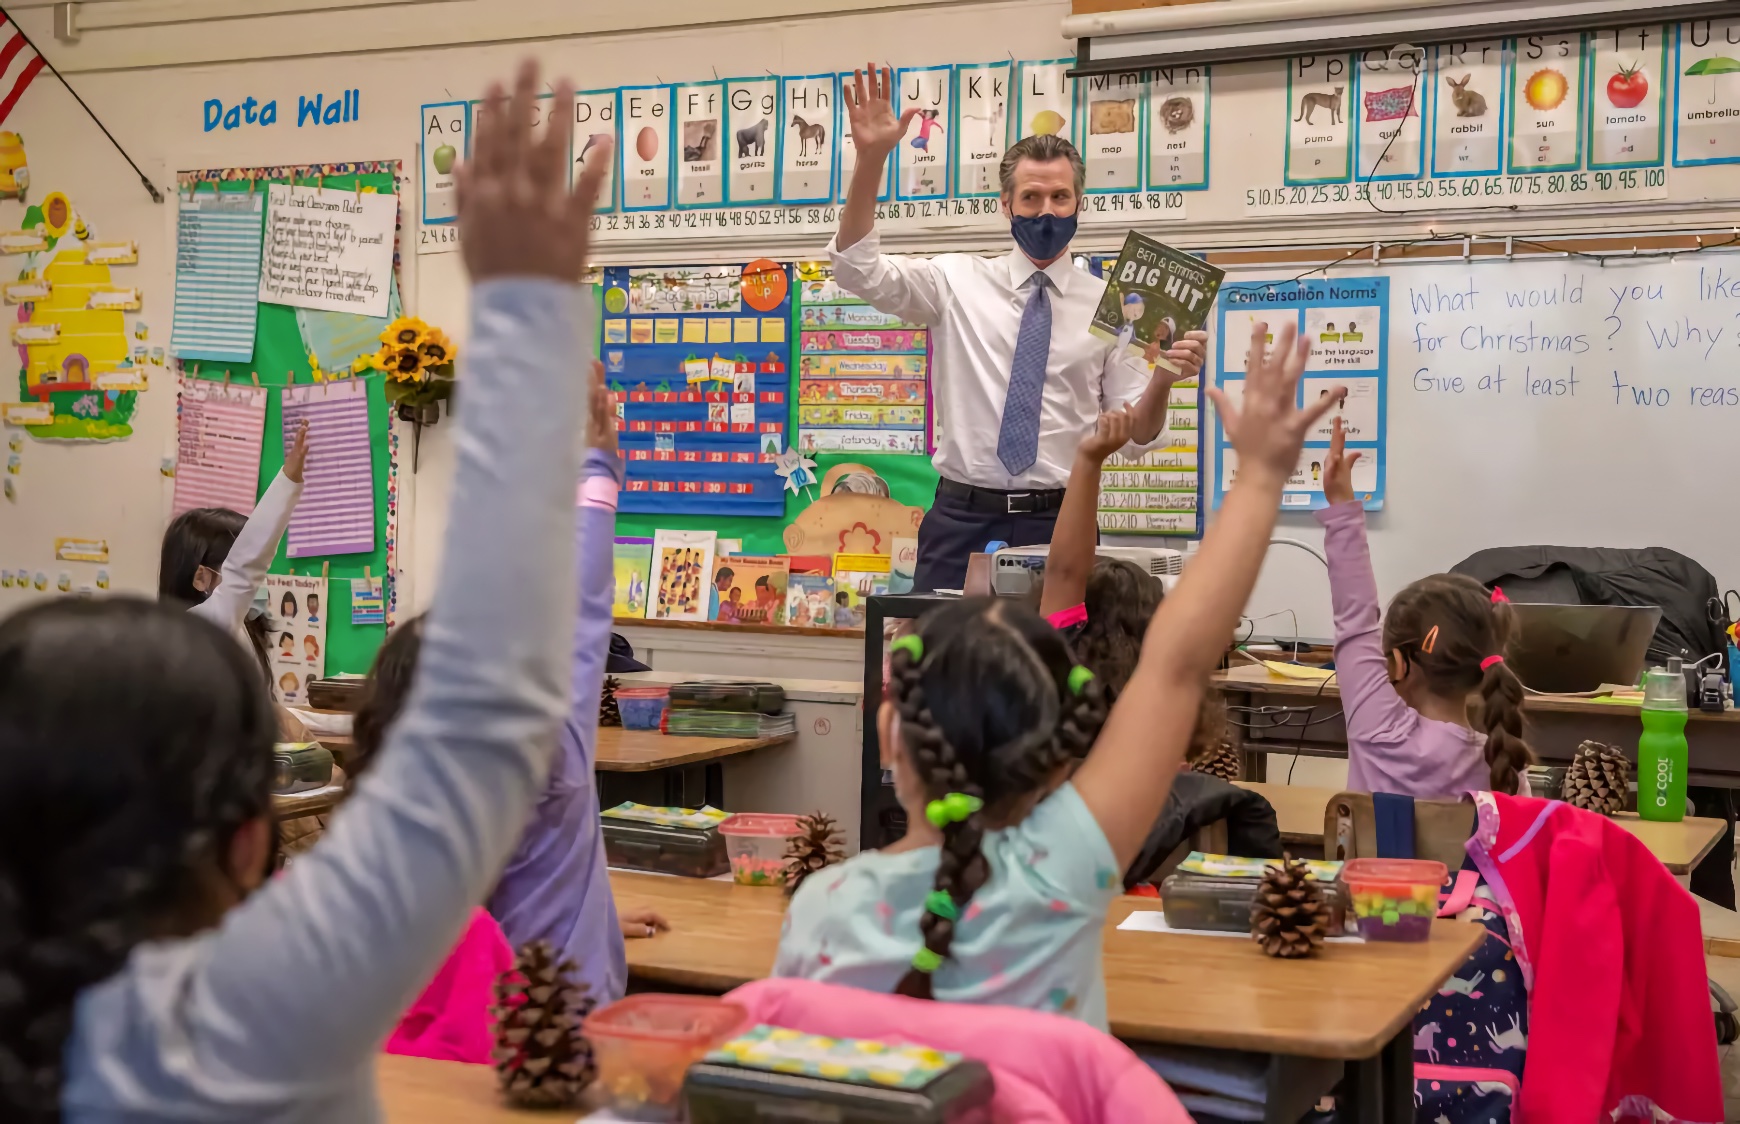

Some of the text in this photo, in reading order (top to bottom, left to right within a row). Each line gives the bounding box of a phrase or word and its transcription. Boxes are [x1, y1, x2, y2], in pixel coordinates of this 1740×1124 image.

[204, 88, 359, 132] Data Wall
[1687, 108, 1740, 120] umbrella
[1536, 119, 1555, 128] sun
[1606, 114, 1647, 125] tomato
[1450, 123, 1483, 134] rabbit
[1304, 135, 1333, 145] puma
[1101, 146, 1122, 154] map
[912, 154, 936, 164] jump
[1645, 169, 1665, 187] 100
[1165, 192, 1183, 209] 100
[1136, 247, 1157, 265] BEN
[755, 285, 772, 299] Up
[1119, 260, 1204, 312] BIG HIT
[1410, 266, 1740, 315] What would you like
[1227, 287, 1377, 303] Conversation Norms
[846, 313, 883, 325] Monday
[843, 334, 880, 348] Tuesday
[1413, 321, 1448, 353] for
[1460, 320, 1590, 354] Christmas
[1646, 317, 1723, 361] Why
[769, 363, 776, 373] 4
[839, 360, 888, 373] Wednesday
[841, 383, 883, 396] Thursday
[1413, 367, 1465, 393] Give
[1477, 364, 1507, 393] at
[1526, 365, 1580, 396] least
[1612, 370, 1670, 407] two
[844, 409, 872, 422] Friday
